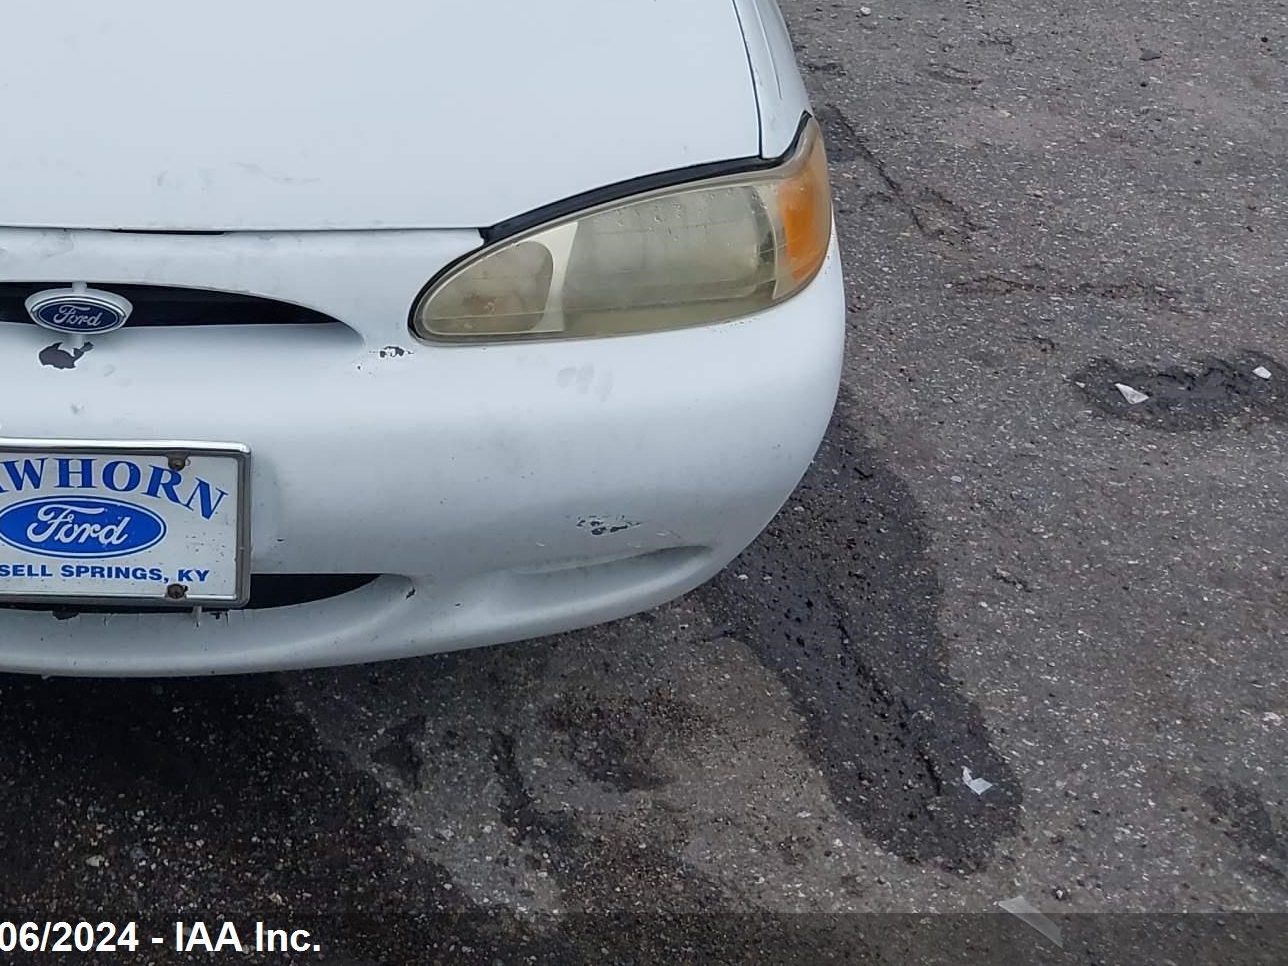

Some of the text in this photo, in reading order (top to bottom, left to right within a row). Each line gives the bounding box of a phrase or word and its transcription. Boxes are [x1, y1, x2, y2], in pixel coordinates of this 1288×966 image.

[53, 304, 103, 327] Ford
[26, 504, 131, 545] Ford
[60, 564, 170, 584] SPRINGS,
[177, 568, 211, 583] KY
